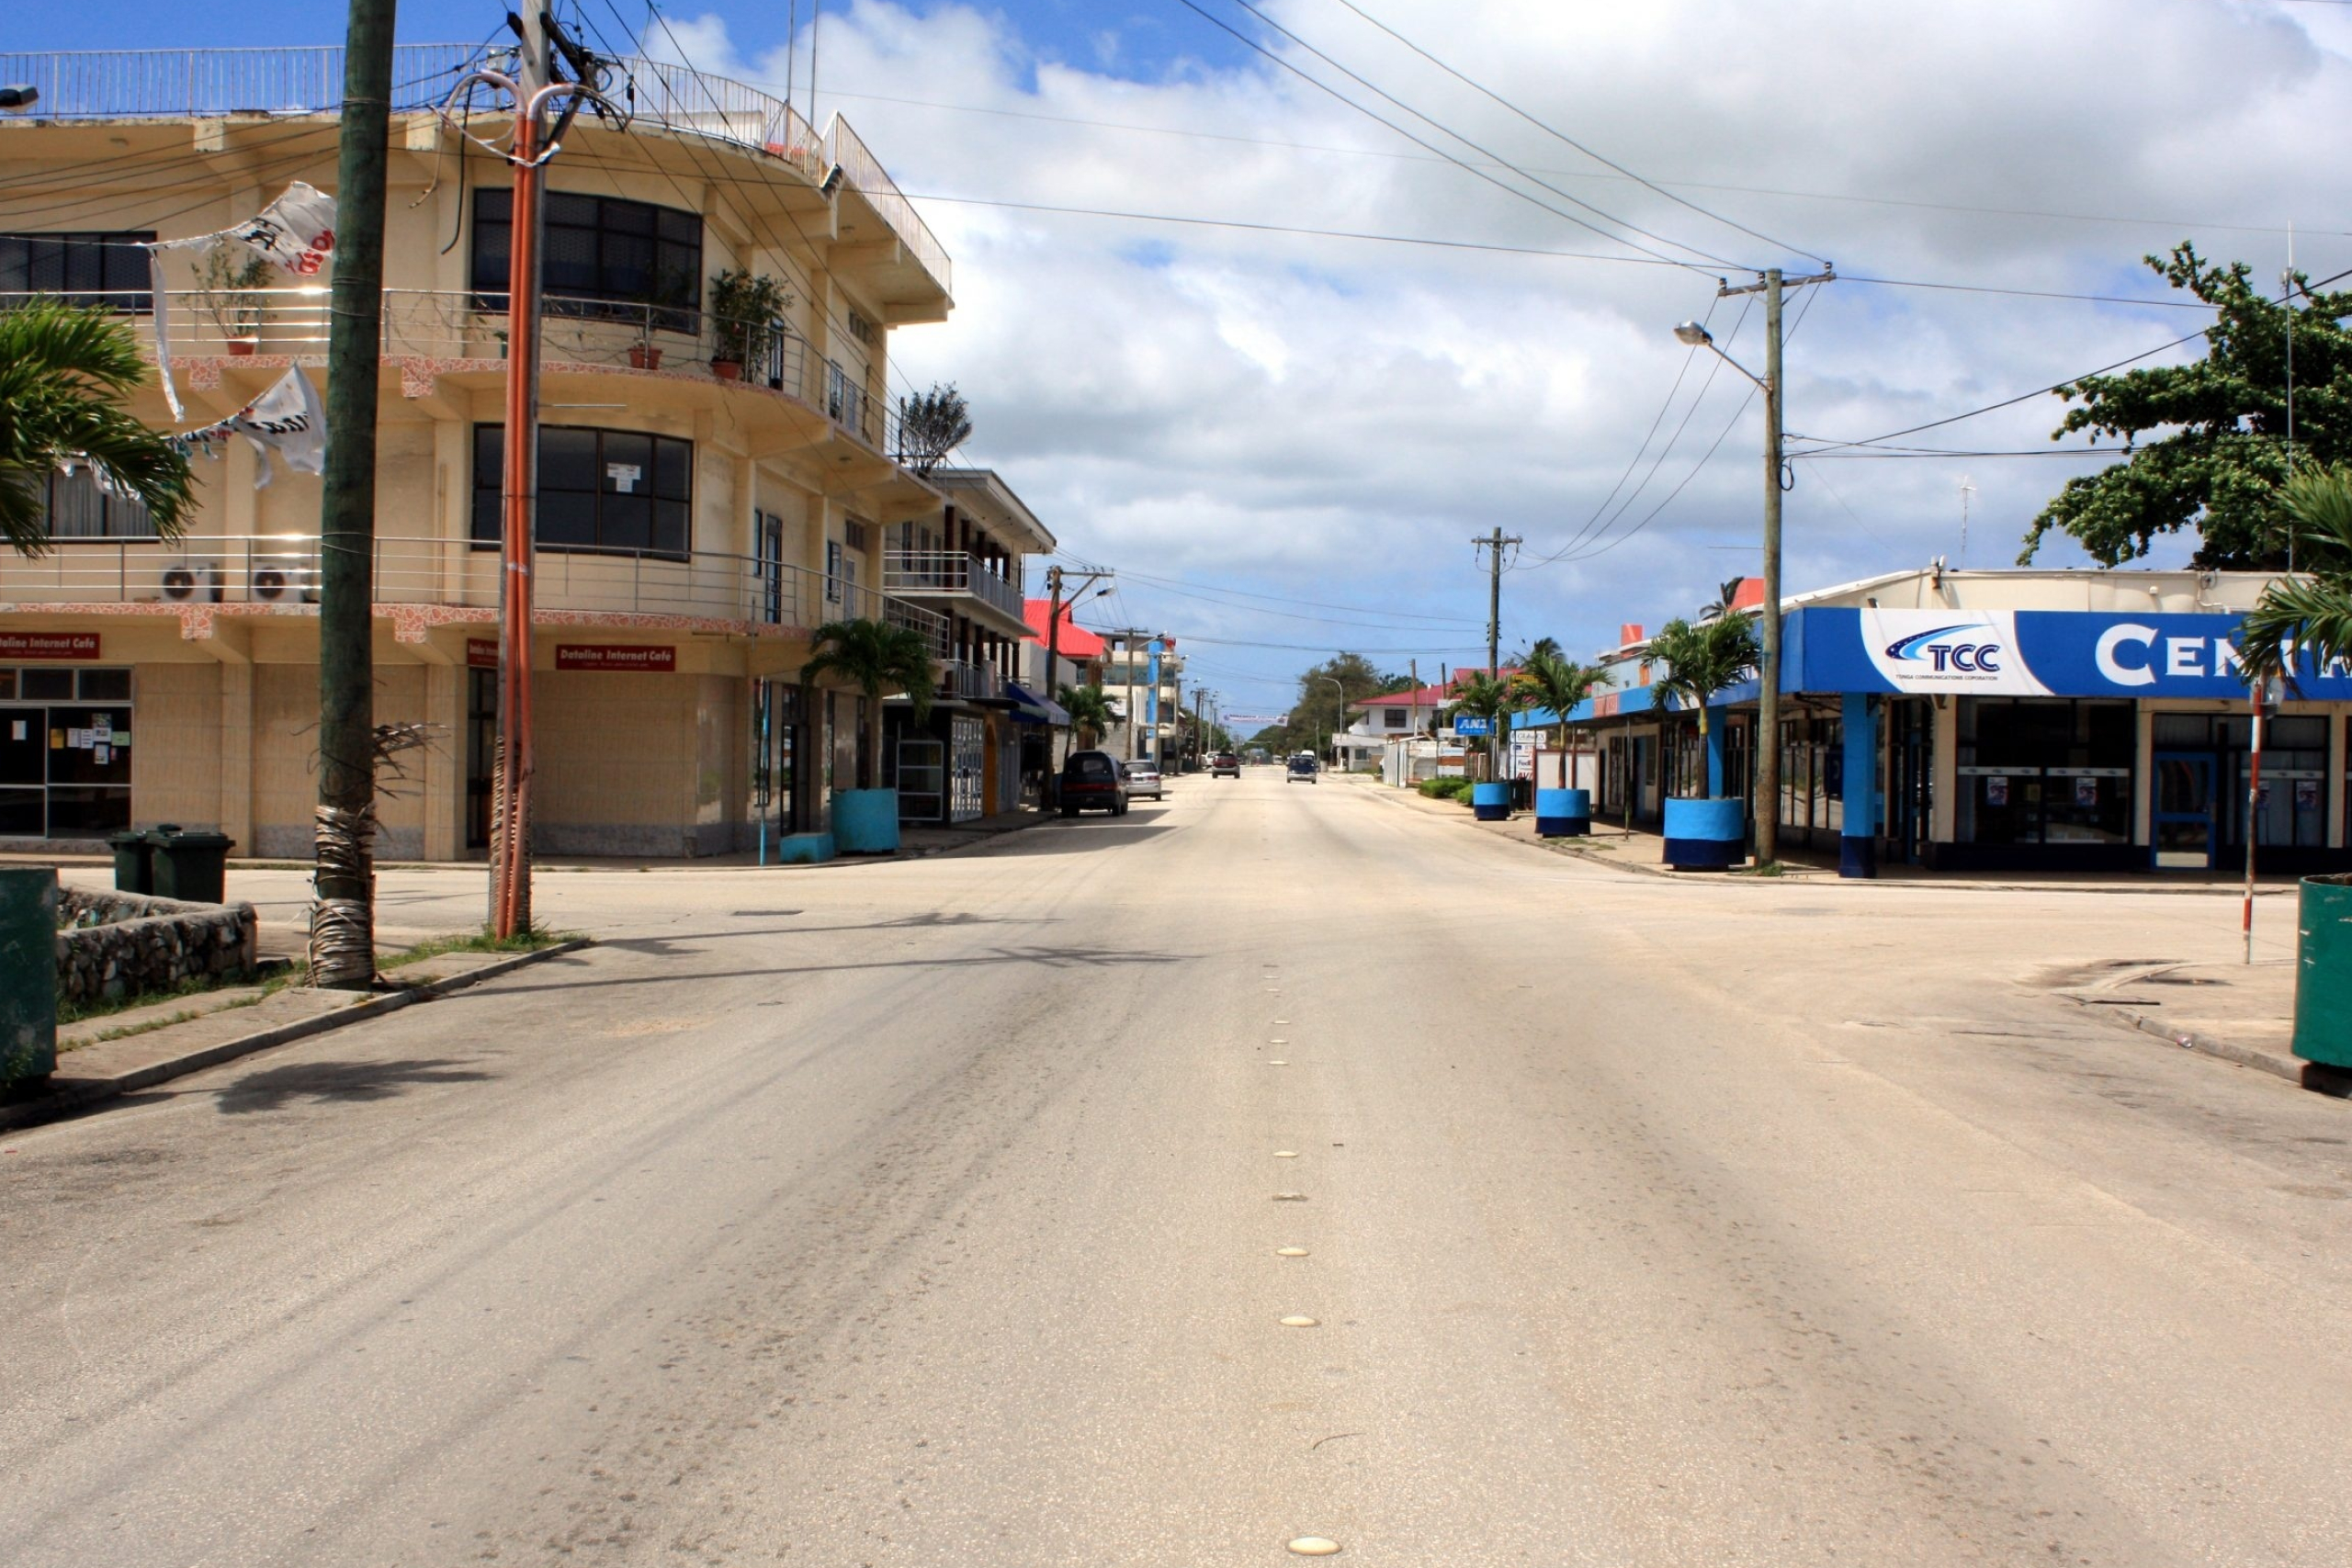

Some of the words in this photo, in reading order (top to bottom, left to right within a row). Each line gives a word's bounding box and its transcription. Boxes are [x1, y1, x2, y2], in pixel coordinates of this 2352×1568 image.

[29, 637, 71, 648] Internet
[560, 649, 604, 660] Dataline
[606, 649, 648, 660] Internet
[1928, 644, 2000, 671] TCC
[1459, 718, 1487, 729] ANZ
